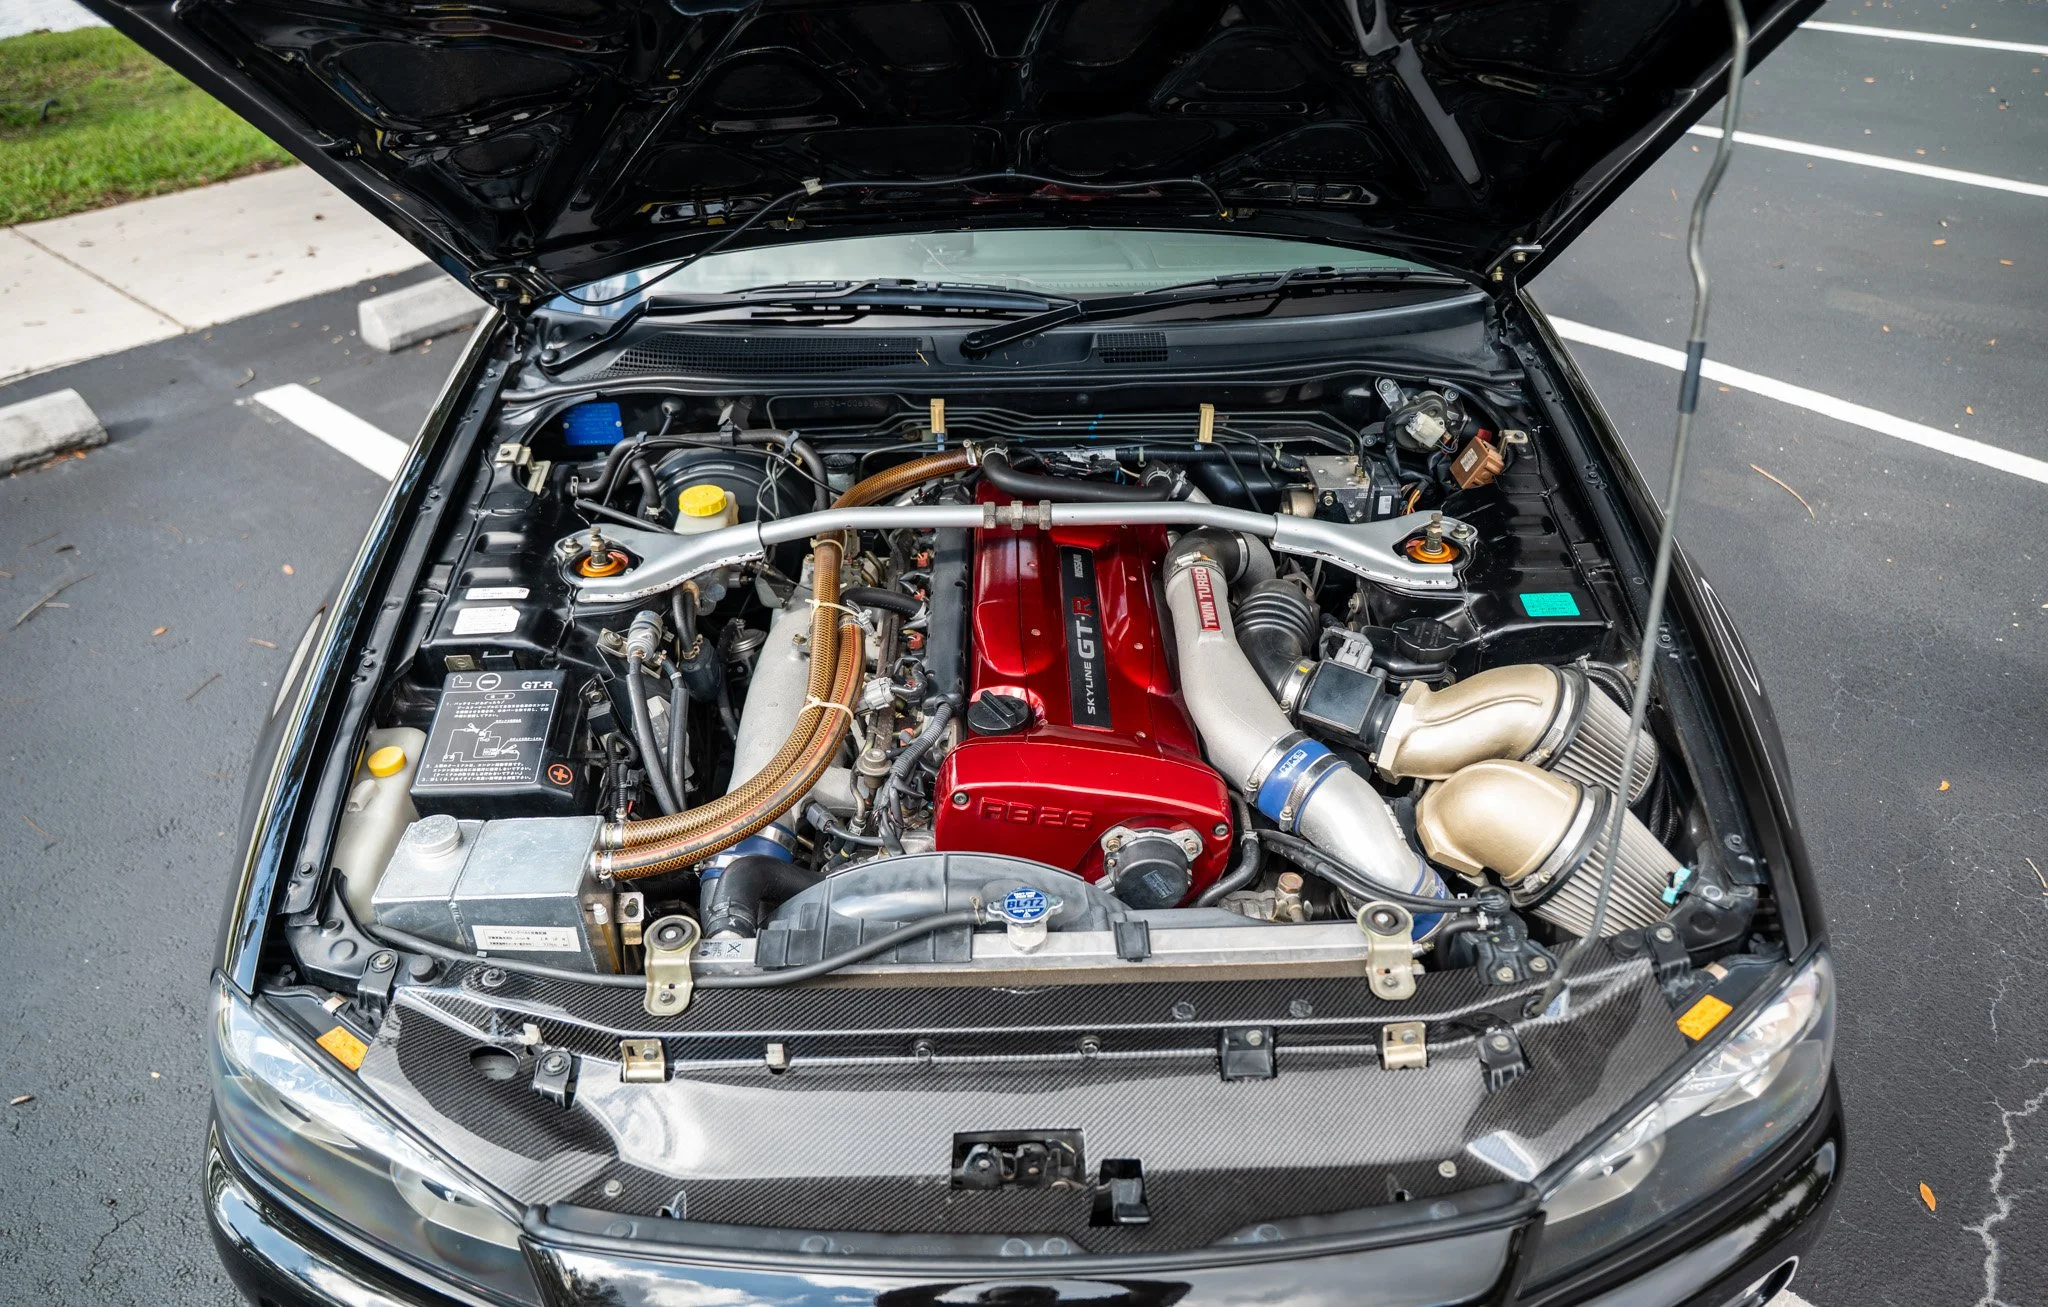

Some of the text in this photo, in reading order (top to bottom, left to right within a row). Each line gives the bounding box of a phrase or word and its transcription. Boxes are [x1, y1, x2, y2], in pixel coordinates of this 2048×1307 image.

[1194, 567, 1218, 628] TWIN TURBO
[521, 681, 554, 690] GT-R
[1084, 661, 1096, 715] SKYLINE
[1280, 750, 1305, 774] HKS
[979, 796, 1093, 830] RB26
